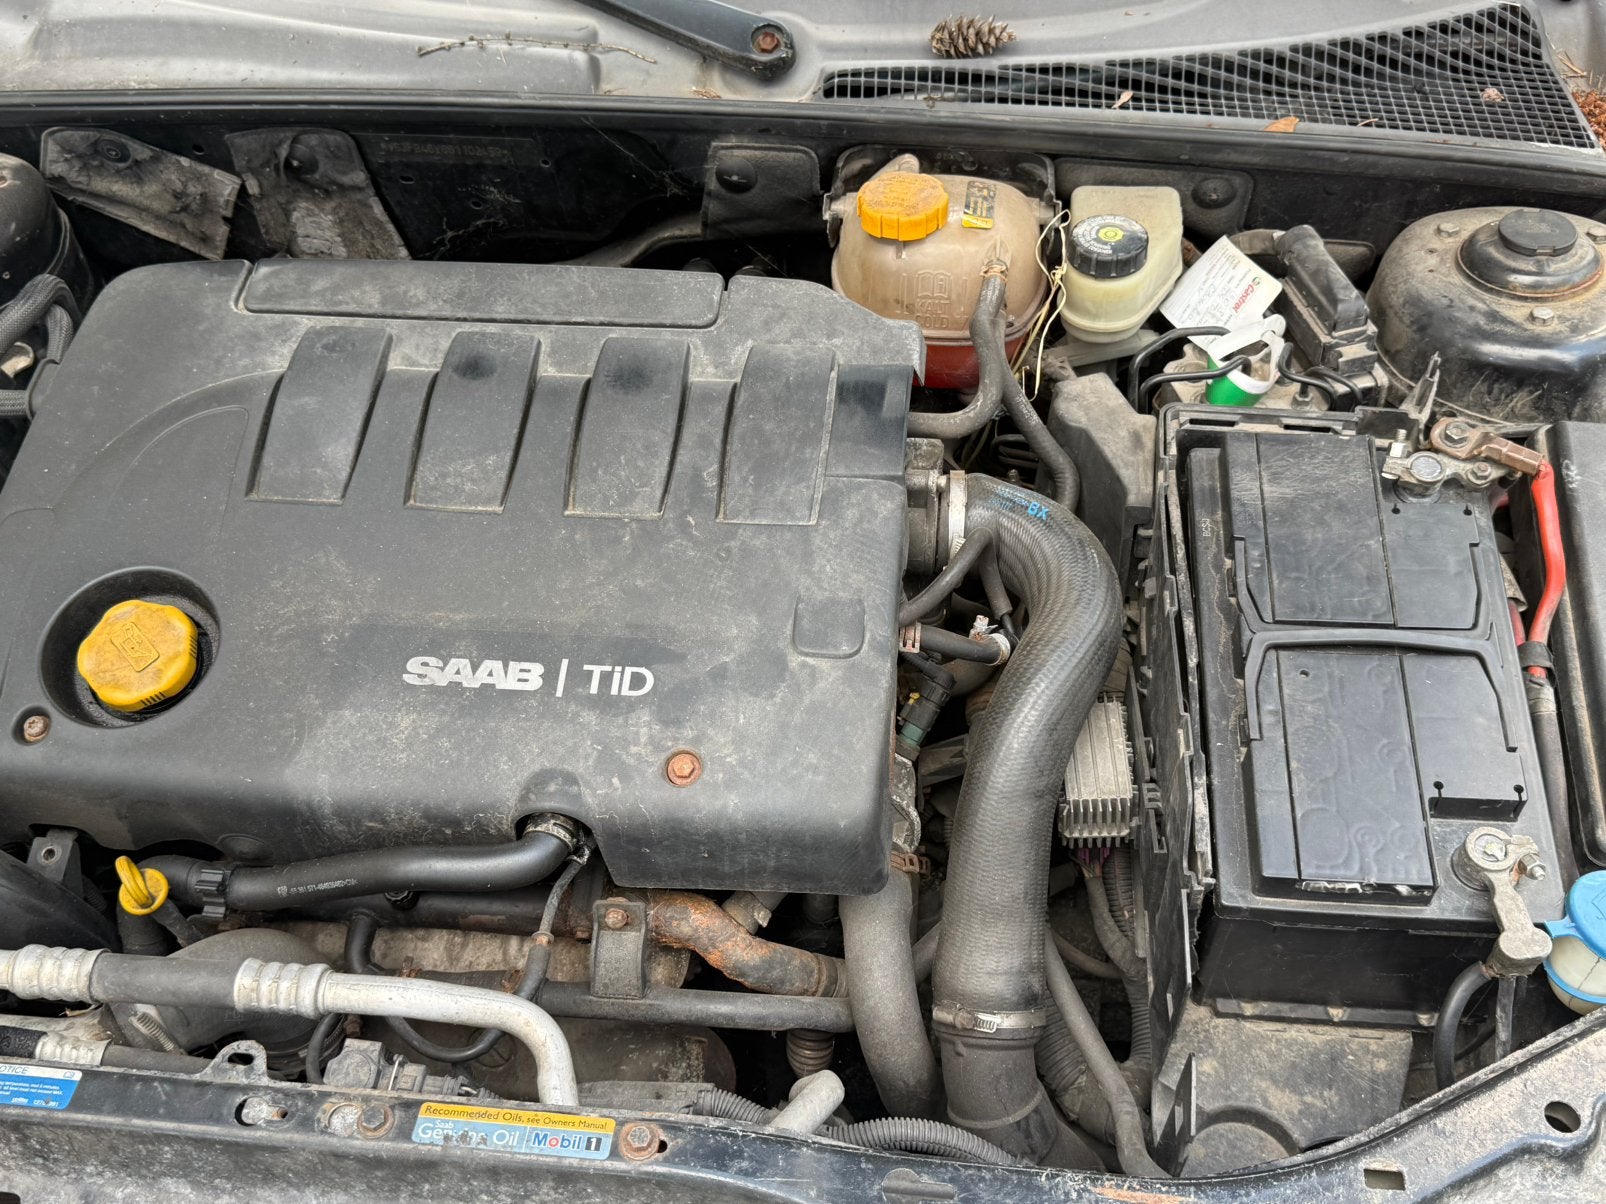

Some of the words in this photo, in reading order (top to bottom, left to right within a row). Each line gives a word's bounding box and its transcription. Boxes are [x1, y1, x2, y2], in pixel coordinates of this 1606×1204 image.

[1233, 284, 1255, 314] Castrol
[402, 656, 544, 691] SAAB
[583, 664, 655, 696] TiD
[424, 1105, 499, 1120] Recommended
[543, 1116, 576, 1127] Owners
[578, 1119, 607, 1130] Manual
[435, 1119, 454, 1128] Saab
[493, 1129, 520, 1147] Oil
[532, 1132, 582, 1150] Mobil
